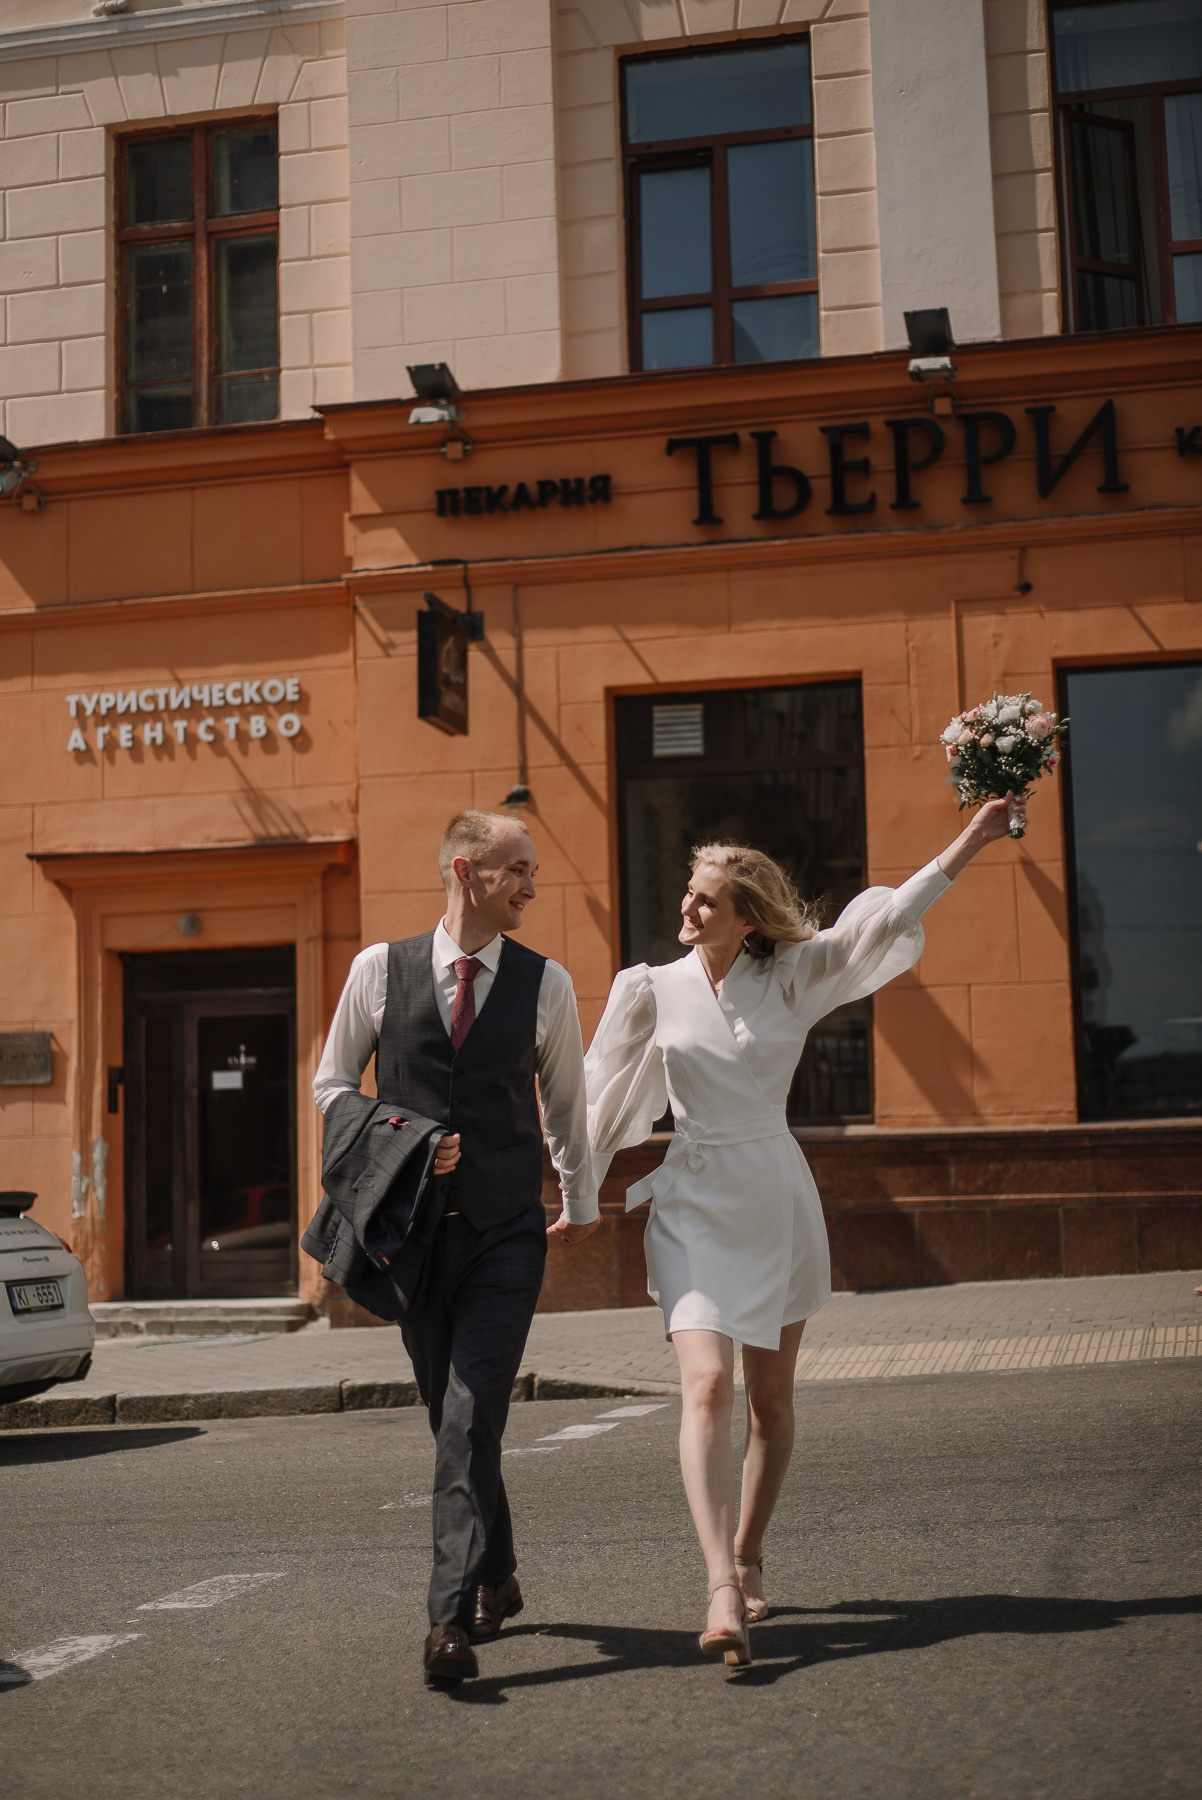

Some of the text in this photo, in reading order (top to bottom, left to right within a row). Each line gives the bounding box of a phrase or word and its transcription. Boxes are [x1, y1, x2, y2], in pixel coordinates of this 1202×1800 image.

[435, 474, 612, 517] ПЕКАРНЯ
[665, 398, 1130, 526] ТЬЕРРИ
[66, 677, 300, 718] ТУРИСТИЧЕСКОЕ
[66, 712, 301, 752] АГЕНТСТВО
